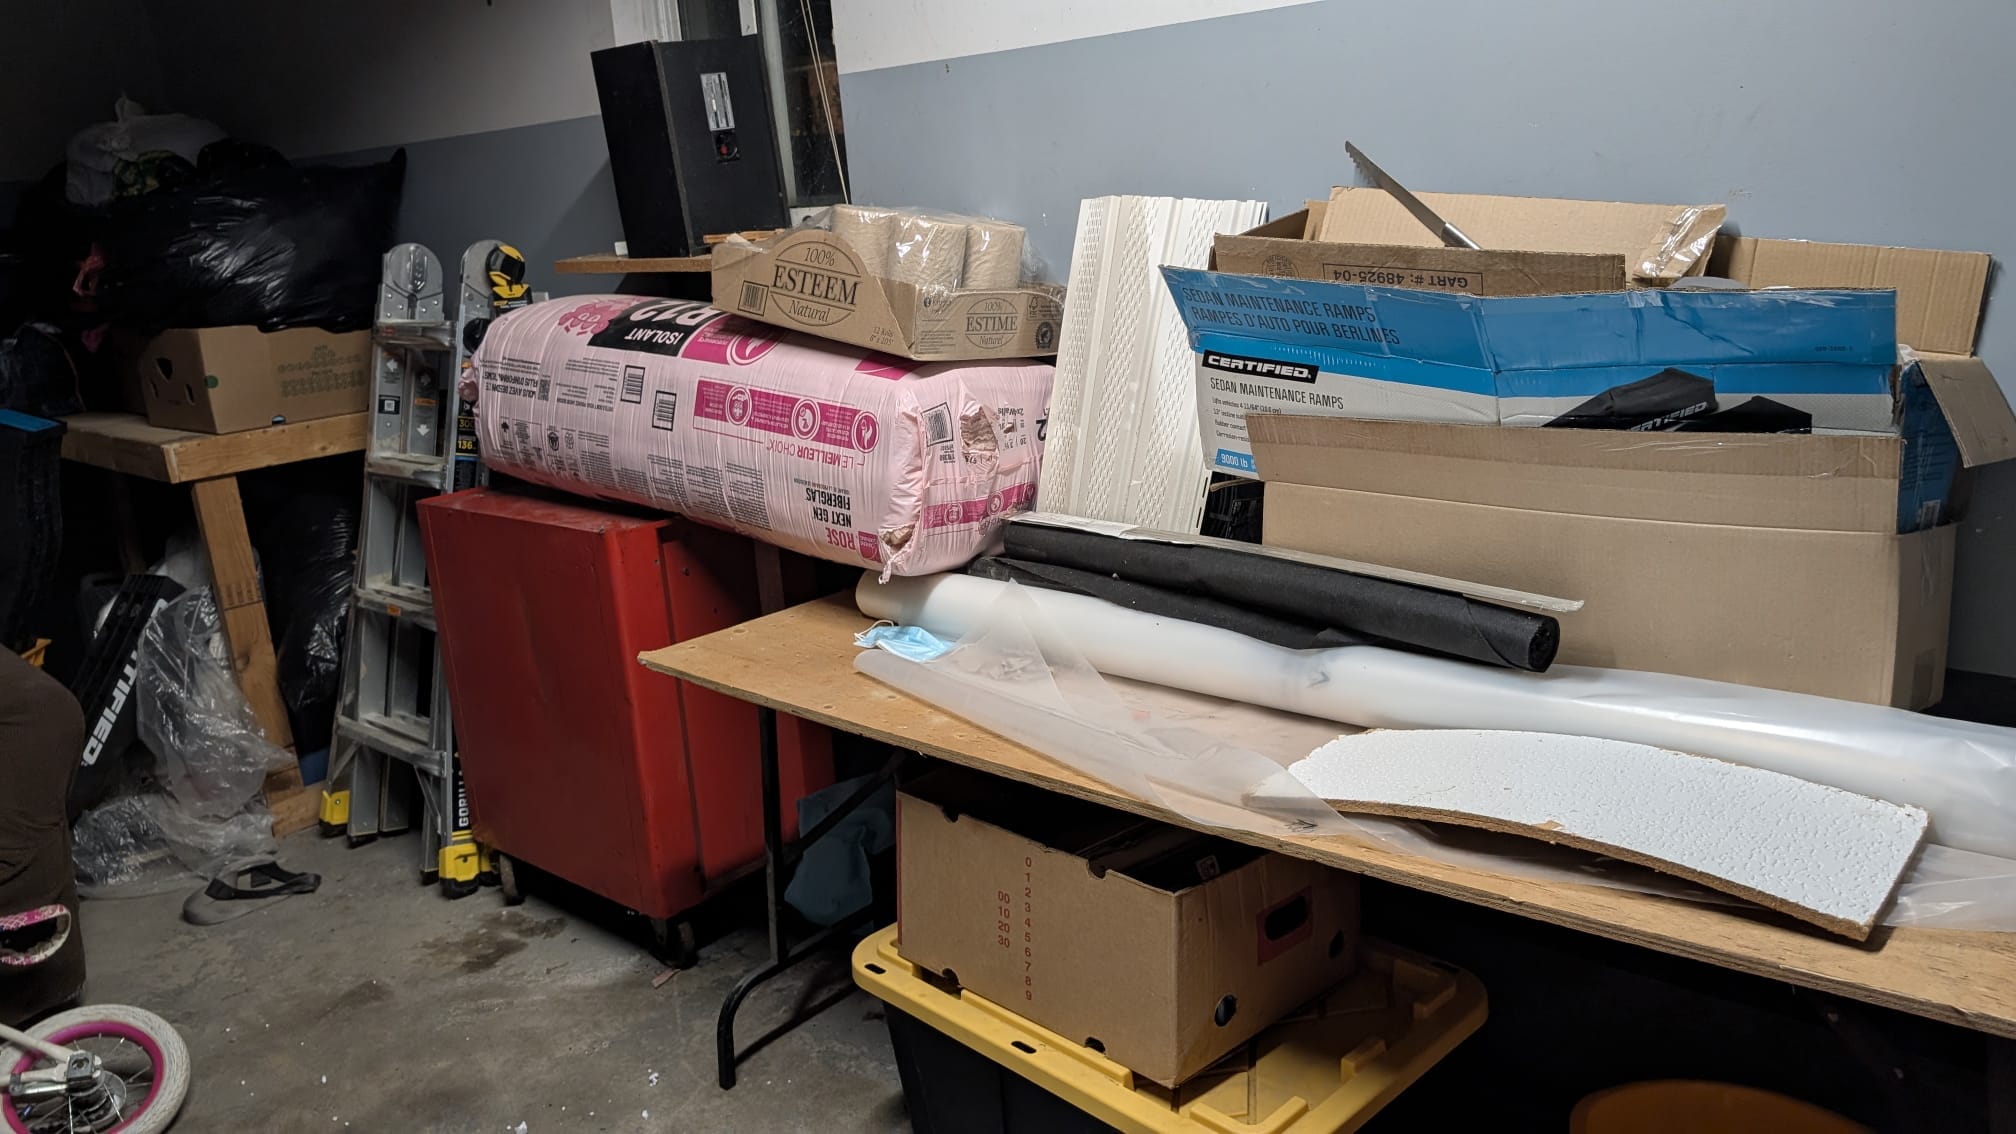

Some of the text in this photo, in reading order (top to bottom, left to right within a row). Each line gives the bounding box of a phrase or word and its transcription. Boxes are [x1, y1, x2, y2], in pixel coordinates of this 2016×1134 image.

[804, 247, 836, 268] 100%
[1333, 268, 1468, 288] GART #: 48925-04
[771, 264, 863, 307] ESTEEM
[788, 299, 832, 323] Natural
[1182, 287, 1377, 323] SEDAN MAINTENANCE RAMPS
[966, 315, 1018, 332] ESTIME
[1191, 307, 1401, 345] RAMPES D'AUTO POUR BERLINES
[624, 327, 685, 345] ISOLANT
[980, 335, 1004, 346] Naturel
[1210, 377, 1344, 410] SEDAN MAINTENANCE RAMPS
[769, 439, 855, 469] LE MEILLEUR CHOIX
[1221, 453, 1249, 468] 9000 lb
[805, 488, 851, 510] FIBERGLAS
[812, 506, 852, 529] NEXT GEN
[825, 527, 856, 550] ROSE
[1025, 857, 1032, 867] 0
[1025, 873, 1031, 883] 1
[998, 891, 1010, 904] 00
[1024, 887, 1031, 898] 2
[998, 906, 1010, 919] 10
[1024, 902, 1031, 913] 3
[998, 920, 1010, 933] 20
[1024, 918, 1031, 928] 4
[998, 935, 1010, 948] 30
[1024, 932, 1031, 943] 5
[1024, 947, 1031, 957] 6
[1024, 962, 1031, 972] 7
[1025, 976, 1031, 986] 8
[1025, 990, 1032, 1001] 9
